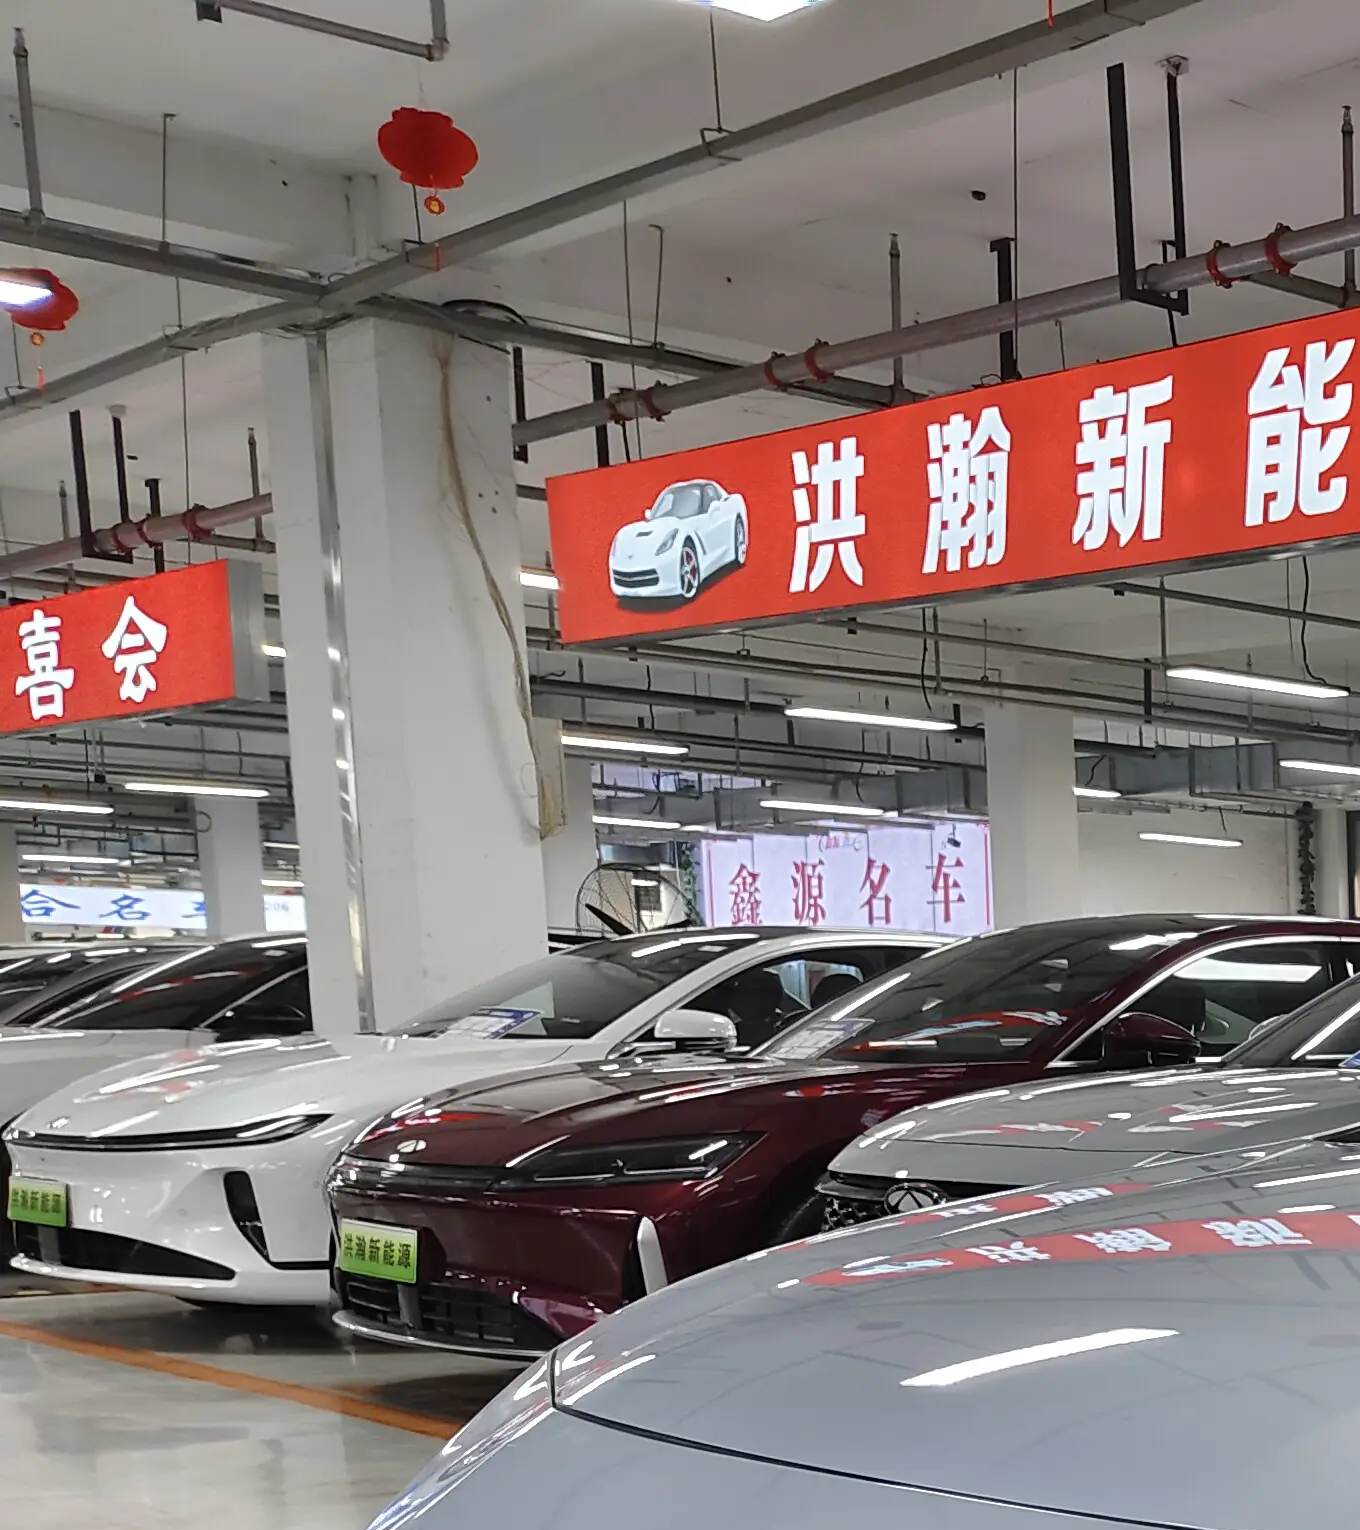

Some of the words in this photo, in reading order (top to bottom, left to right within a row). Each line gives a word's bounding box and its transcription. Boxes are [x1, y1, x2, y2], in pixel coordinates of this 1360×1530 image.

[15, 596, 168, 720] 喜会
[729, 852, 965, 926] 鑫源名车
